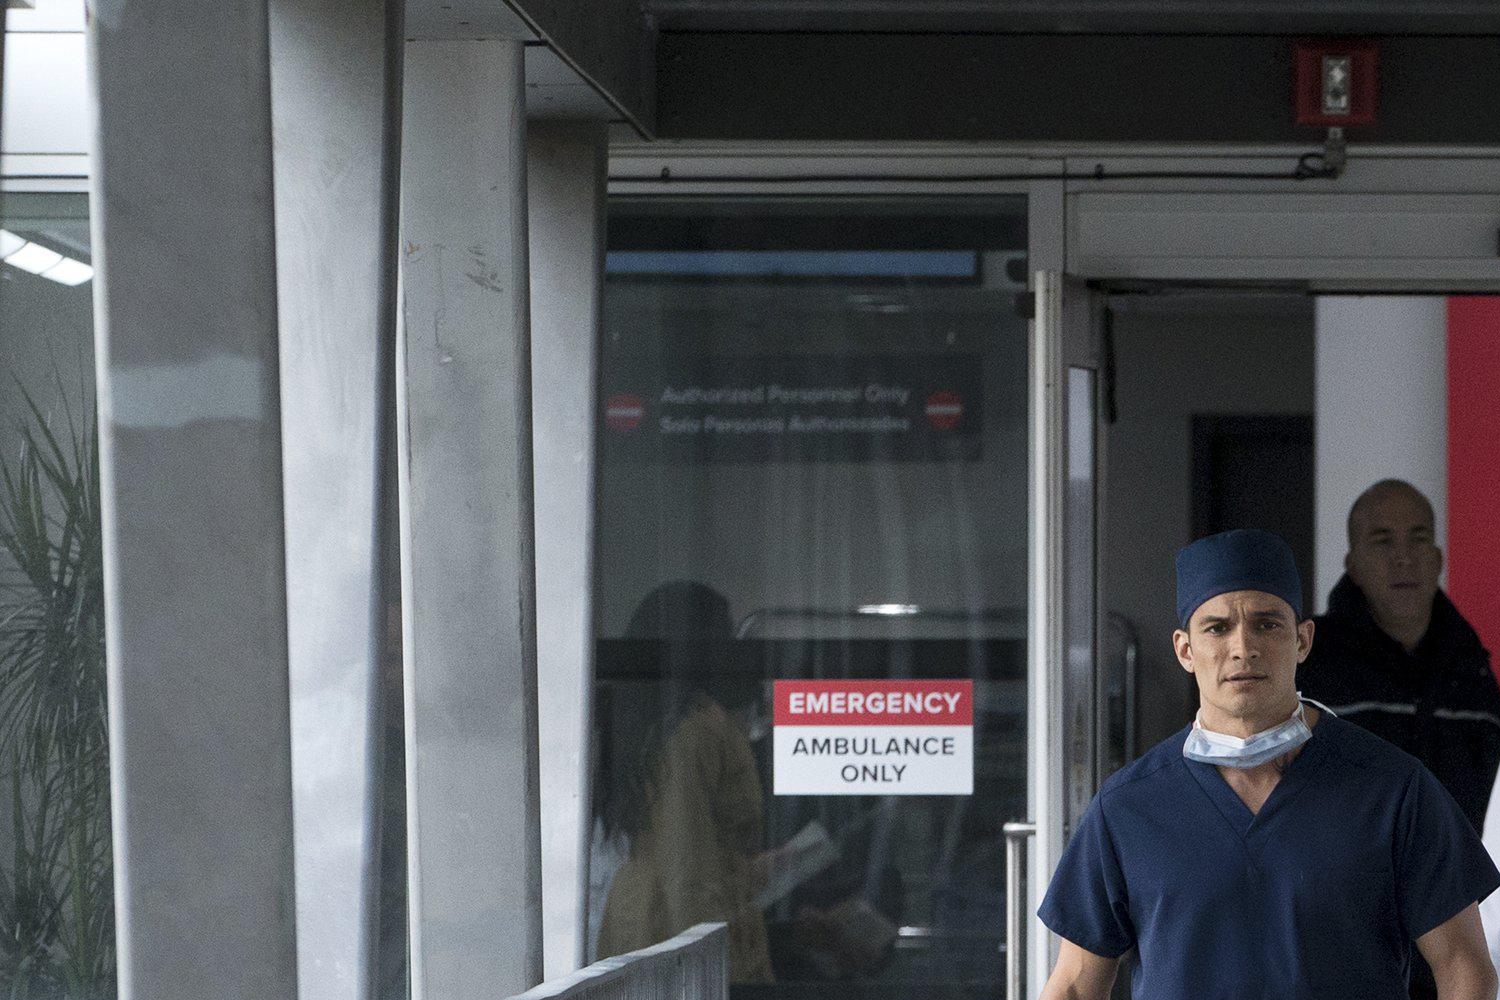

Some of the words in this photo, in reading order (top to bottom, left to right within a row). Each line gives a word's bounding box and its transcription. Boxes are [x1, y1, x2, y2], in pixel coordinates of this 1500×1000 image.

[789, 691, 961, 715] EMERGENCY
[792, 736, 956, 756] AMBULANCE
[840, 764, 908, 783] ONLY
